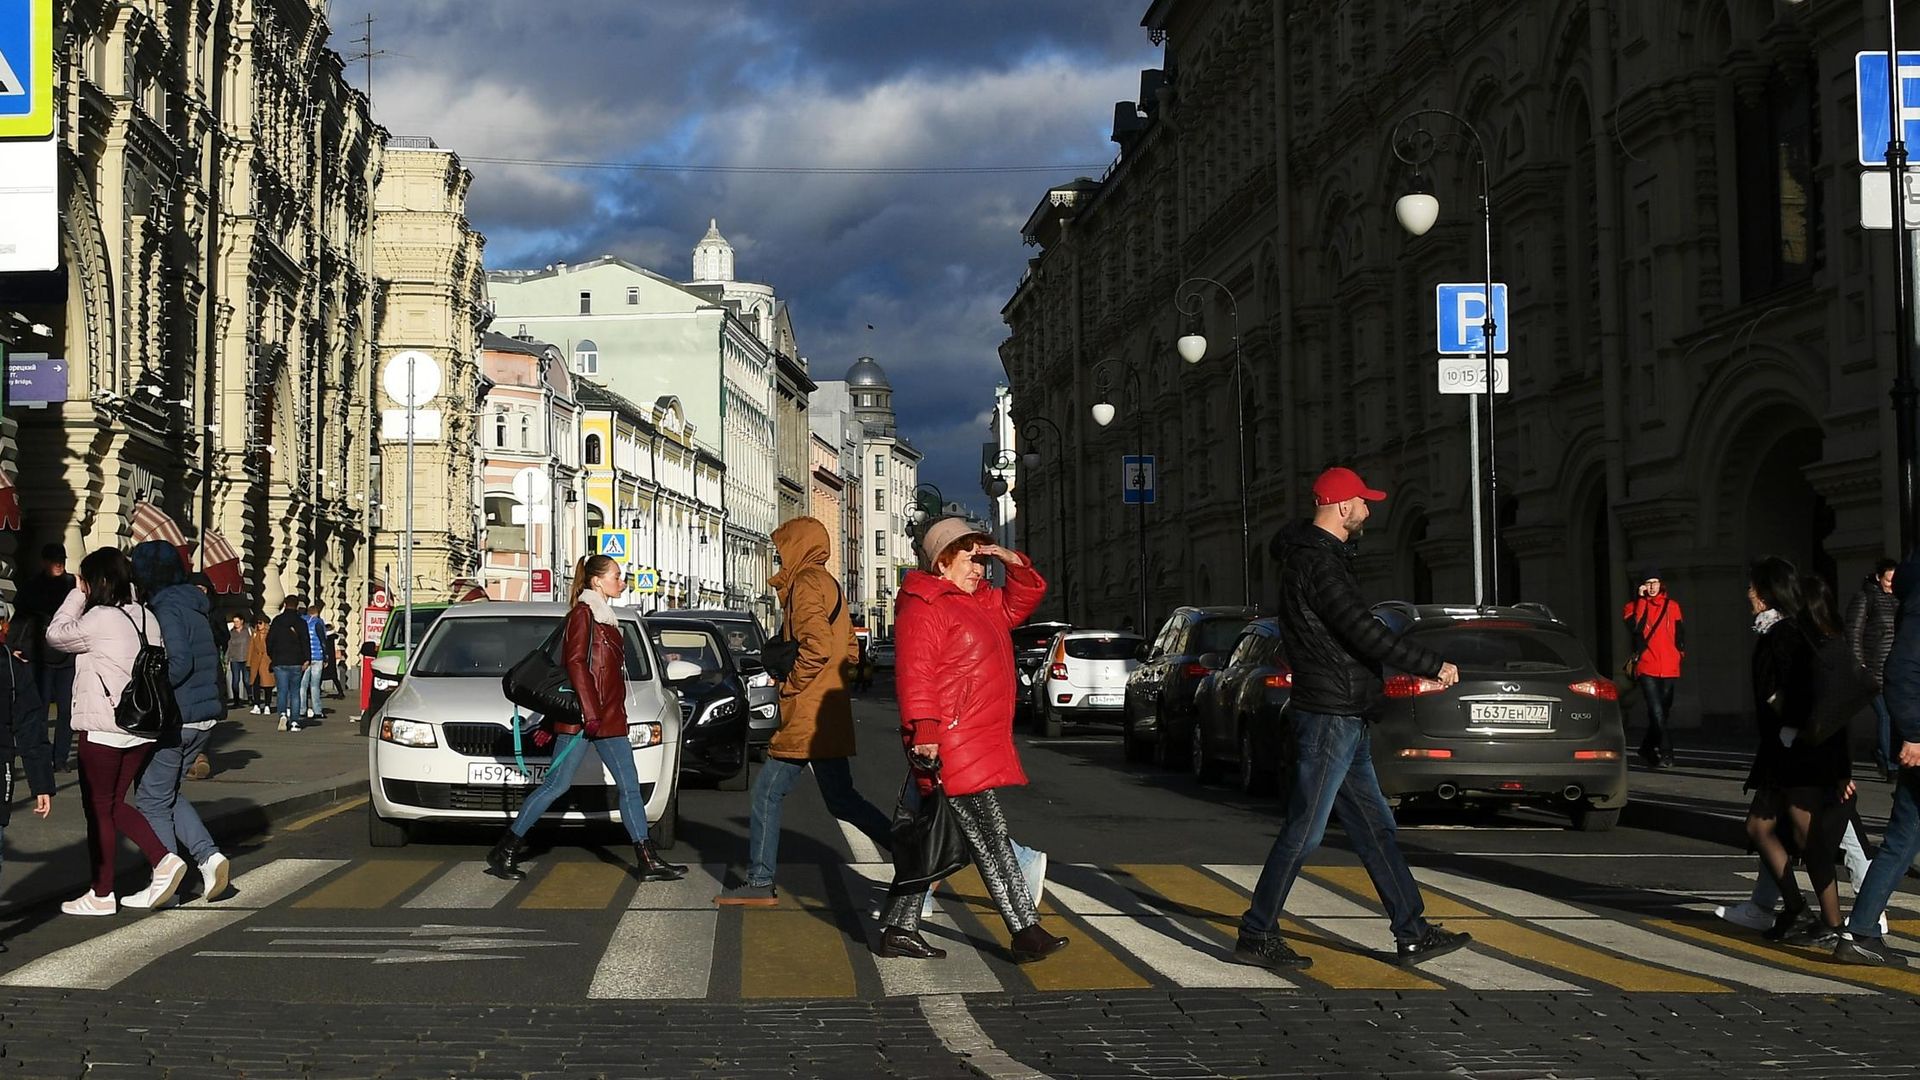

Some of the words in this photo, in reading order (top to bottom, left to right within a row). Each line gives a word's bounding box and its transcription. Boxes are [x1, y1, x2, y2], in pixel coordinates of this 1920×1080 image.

[1457, 292, 1494, 345] P
[1447, 371, 1458, 380] 10
[1462, 370, 1474, 381] 15
[1476, 706, 1523, 719] Т637ЕН
[1526, 706, 1545, 717] 777
